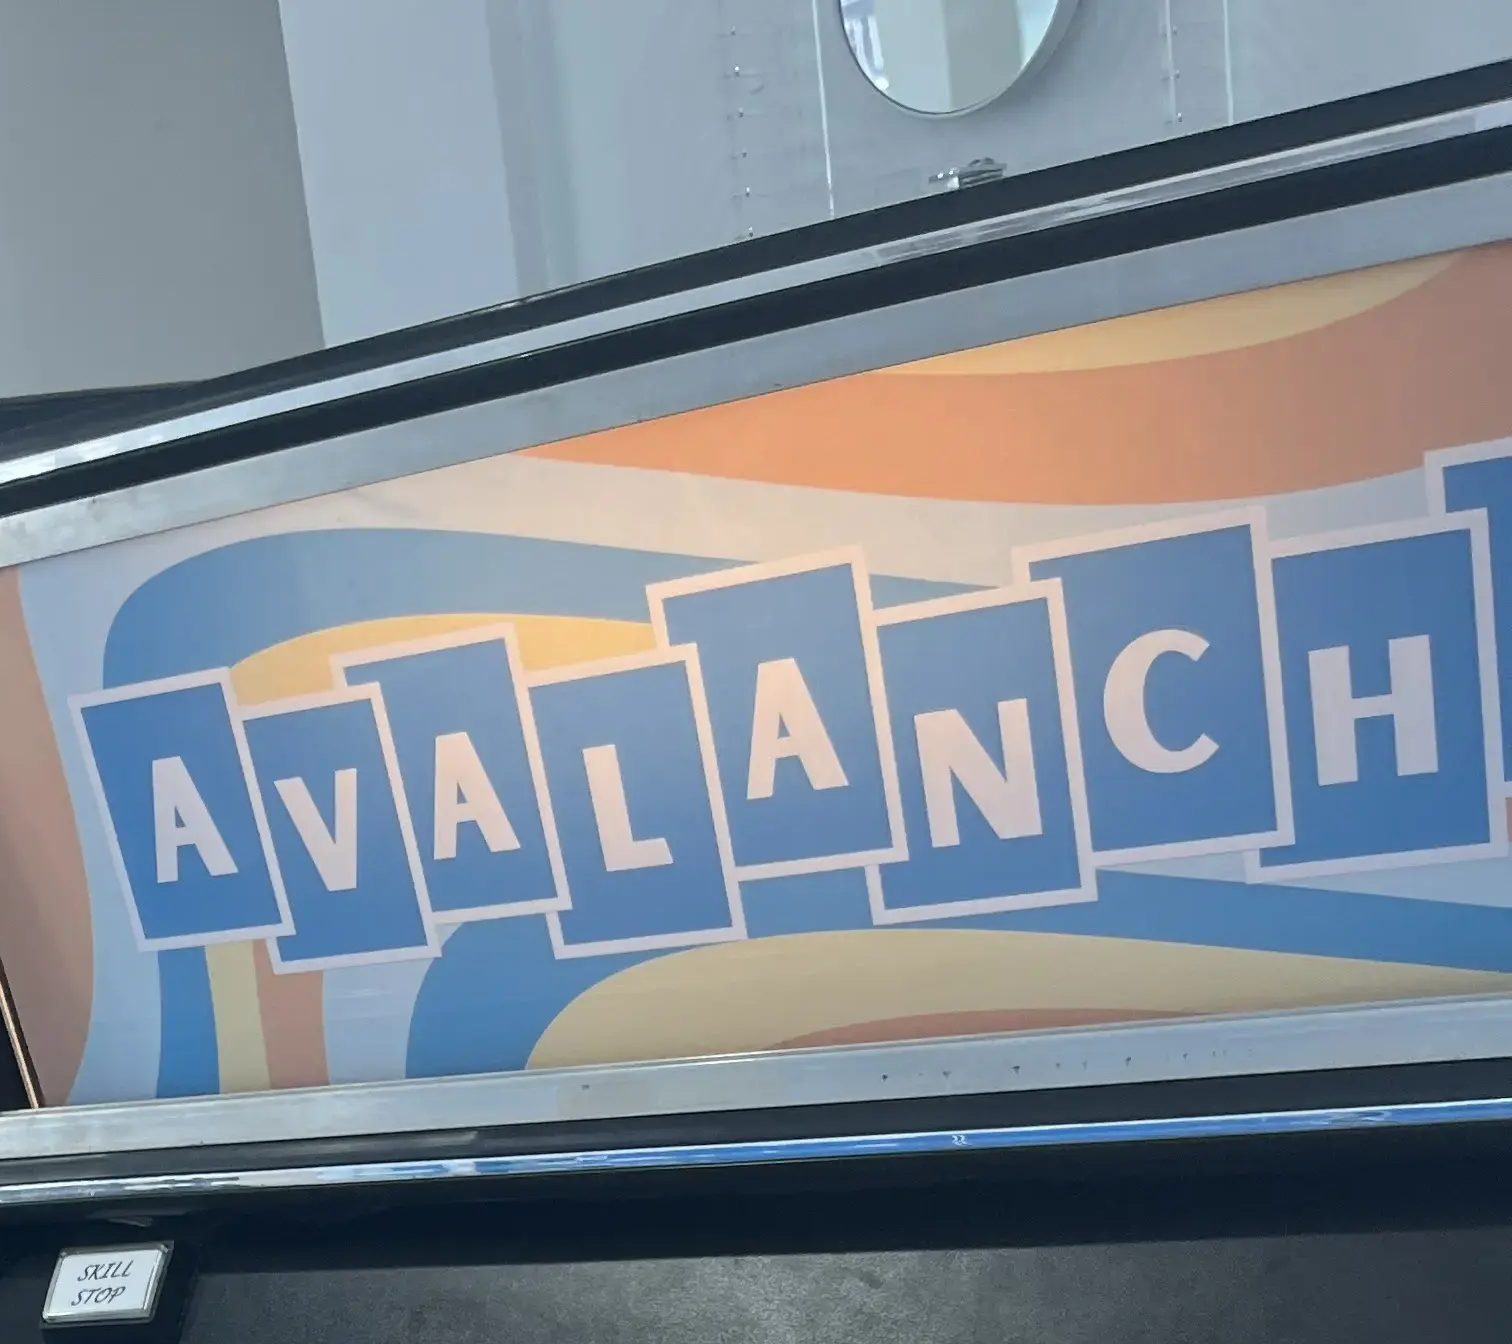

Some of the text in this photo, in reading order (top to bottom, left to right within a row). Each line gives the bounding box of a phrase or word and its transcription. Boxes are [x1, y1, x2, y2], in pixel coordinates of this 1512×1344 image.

[153, 628, 1439, 892] AVALANCH
[77, 1260, 134, 1281] SKILL
[71, 1286, 126, 1306] STOP
